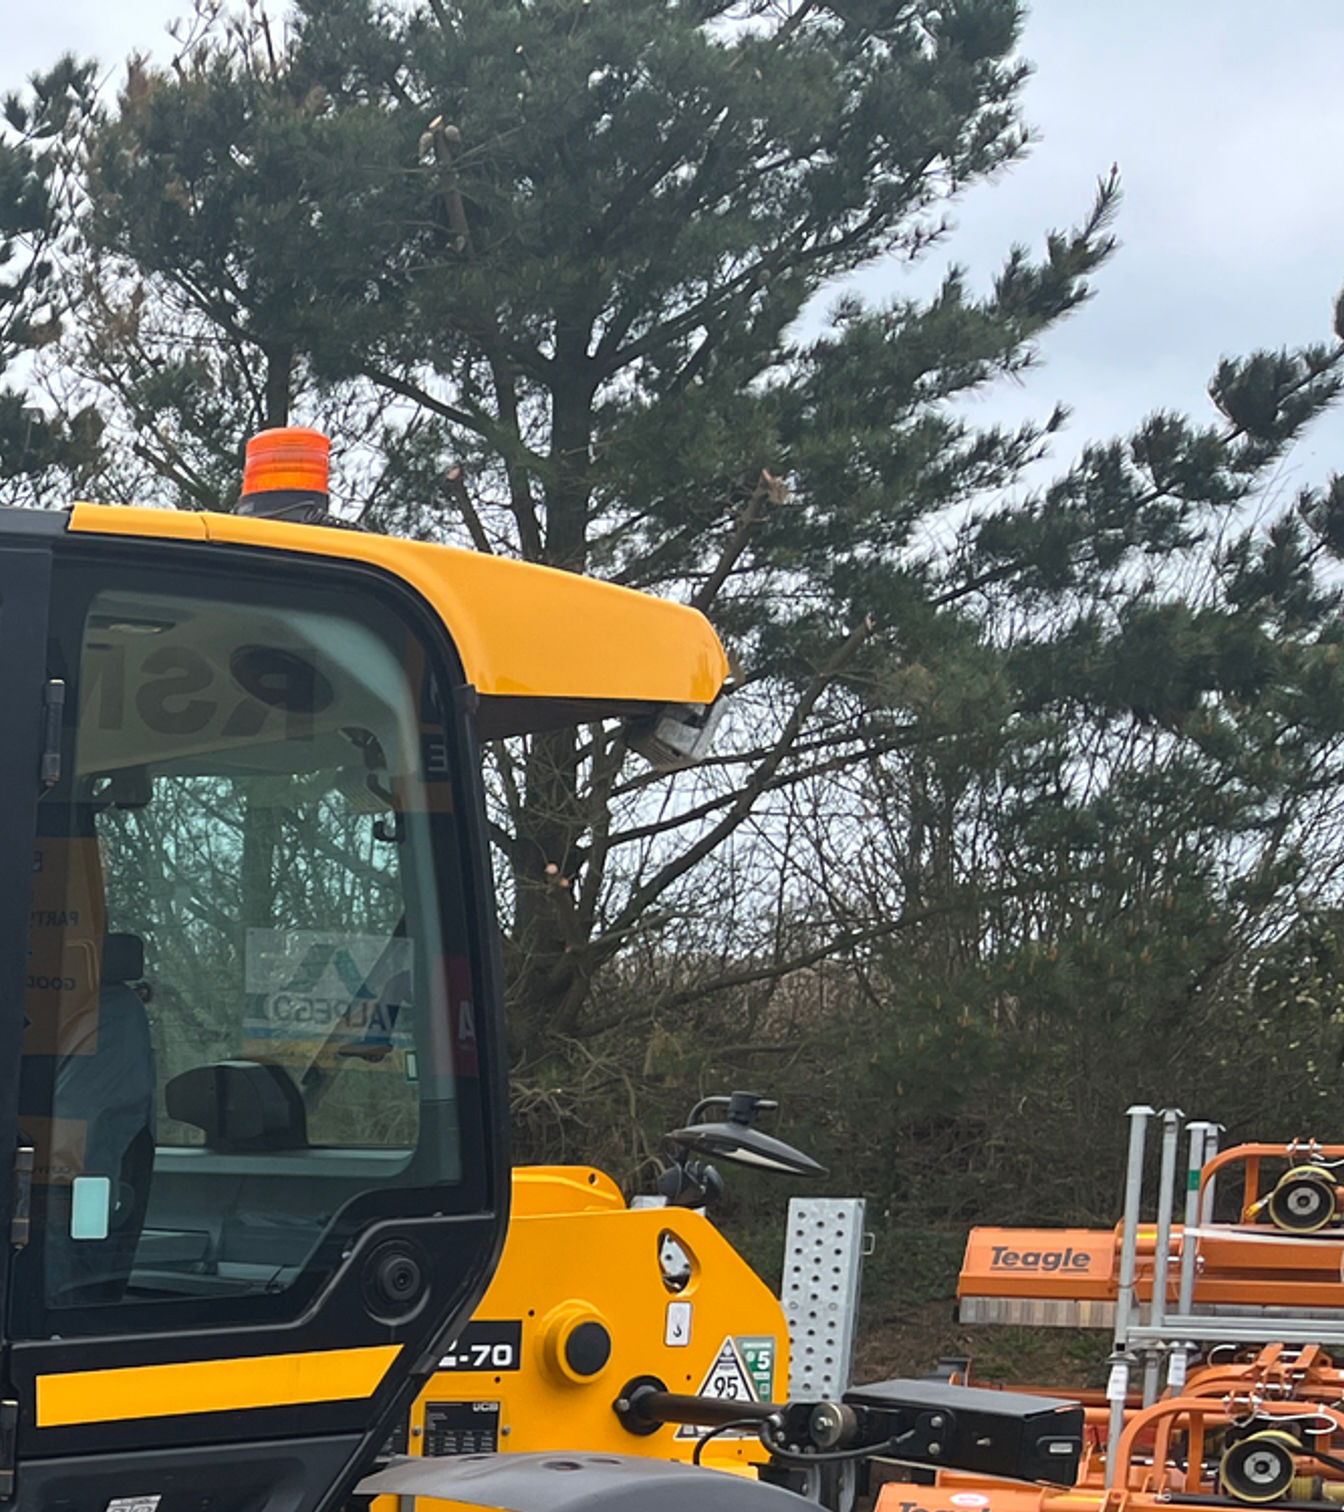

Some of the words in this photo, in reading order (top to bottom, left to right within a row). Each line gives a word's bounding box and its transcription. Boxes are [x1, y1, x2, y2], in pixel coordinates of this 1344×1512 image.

[991, 1246, 1091, 1271] Teagle
[757, 1350, 770, 1370] 5
[714, 1376, 739, 1400] 95
